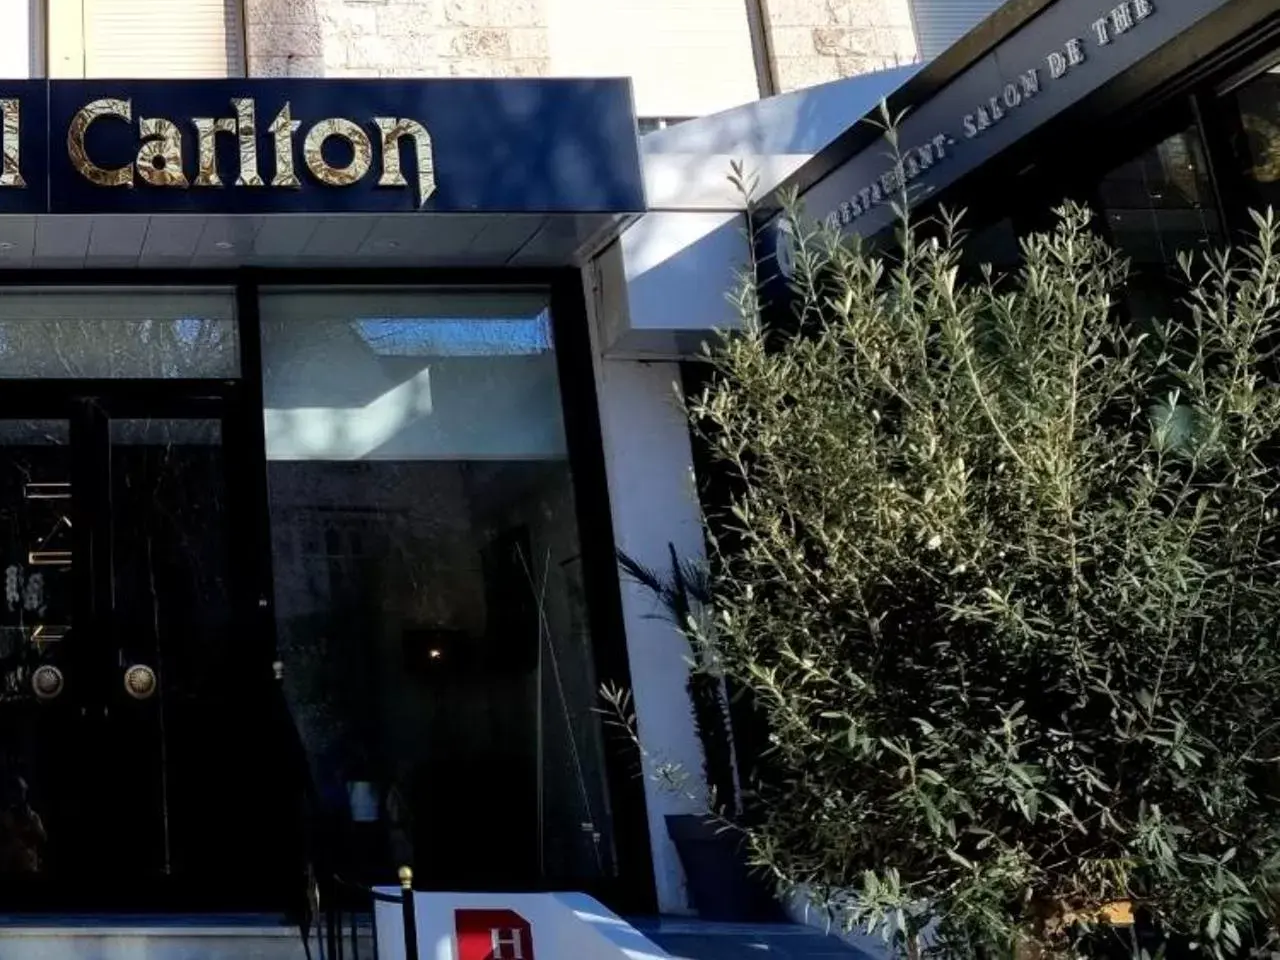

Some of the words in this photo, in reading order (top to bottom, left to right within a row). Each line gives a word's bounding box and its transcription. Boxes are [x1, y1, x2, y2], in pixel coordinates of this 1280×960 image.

[963, 68, 1041, 138] SALON
[1046, 38, 1085, 79] DE
[66, 98, 438, 207] Carlton
[490, 927, 523, 959] H
